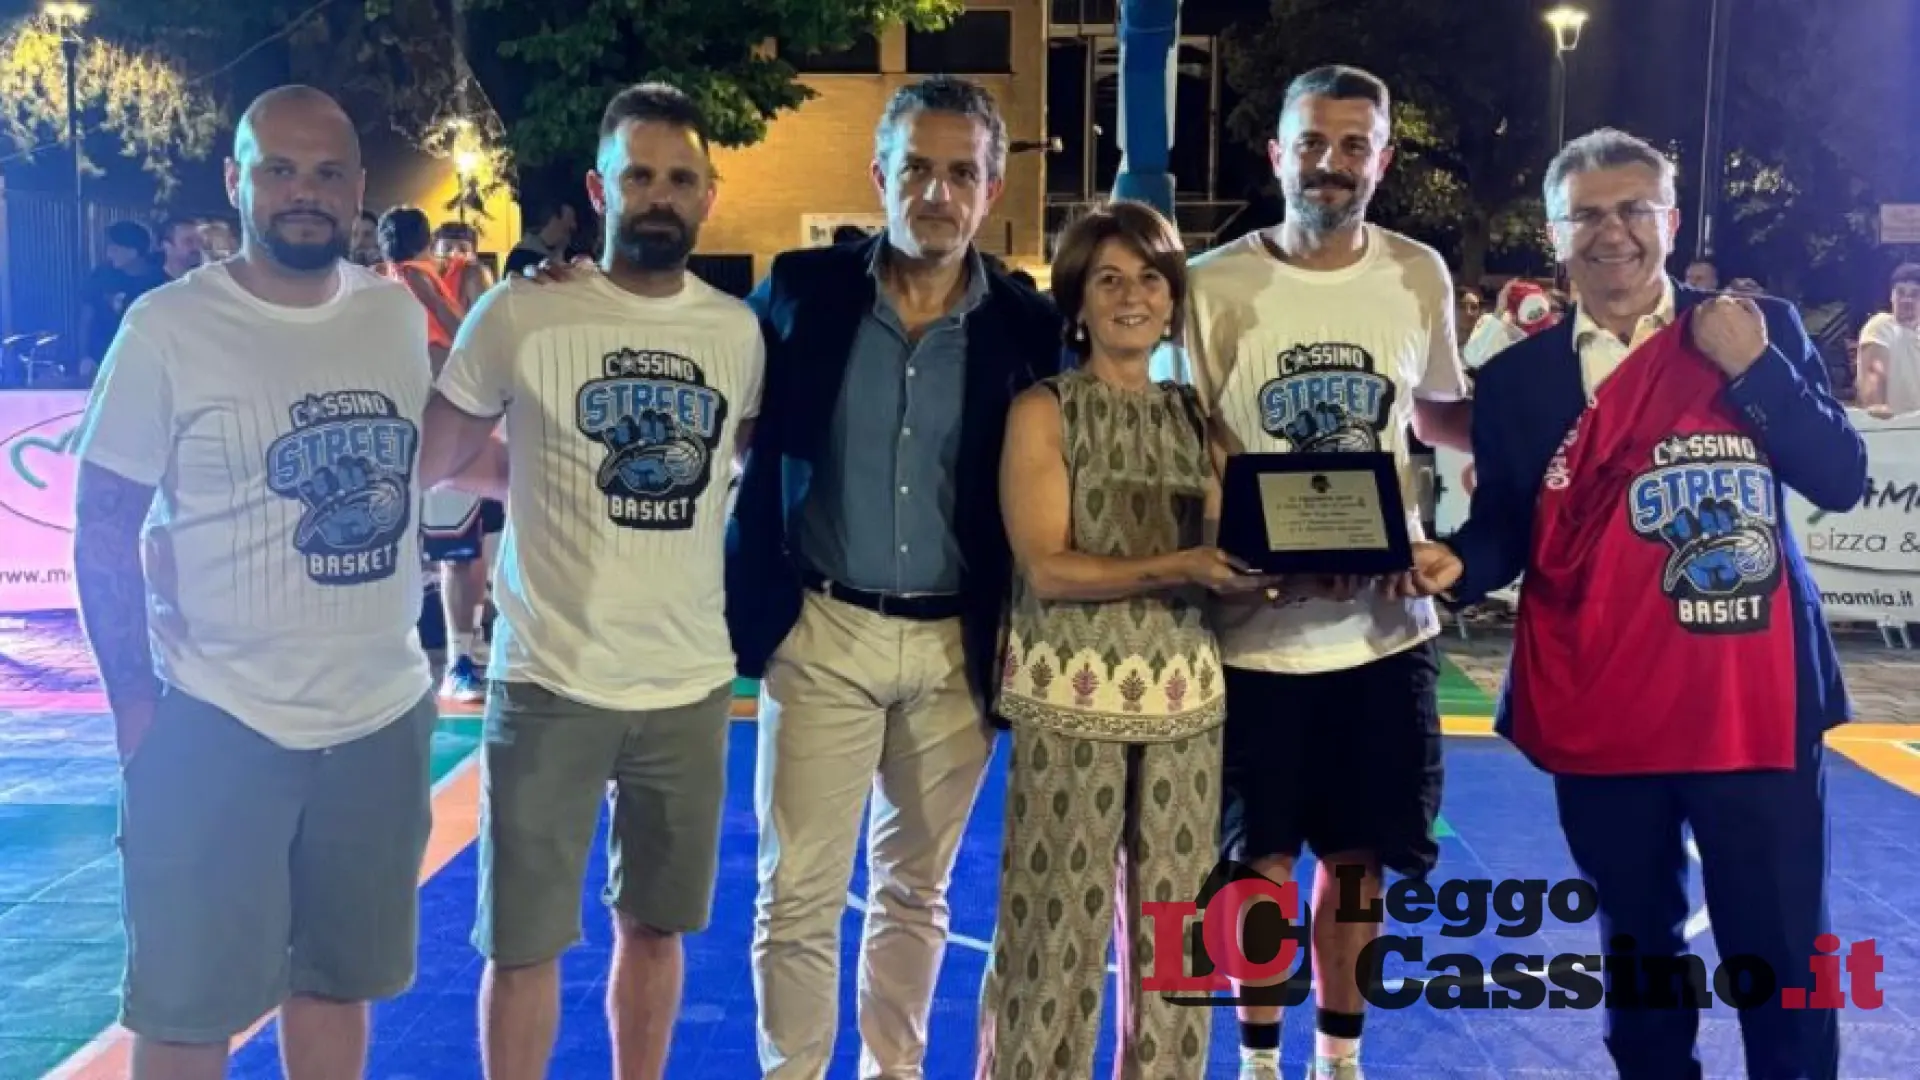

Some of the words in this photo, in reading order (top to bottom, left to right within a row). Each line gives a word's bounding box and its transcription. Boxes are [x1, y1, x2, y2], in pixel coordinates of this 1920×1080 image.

[581, 381, 716, 437] STREET
[1263, 374, 1385, 427] STREET
[270, 421, 412, 488] STREET
[611, 496, 690, 522] BASKET
[1634, 467, 1775, 531] STREET
[310, 545, 393, 577] BASKET
[1807, 527, 1887, 555] pizza
[1900, 531, 1920, 553] &
